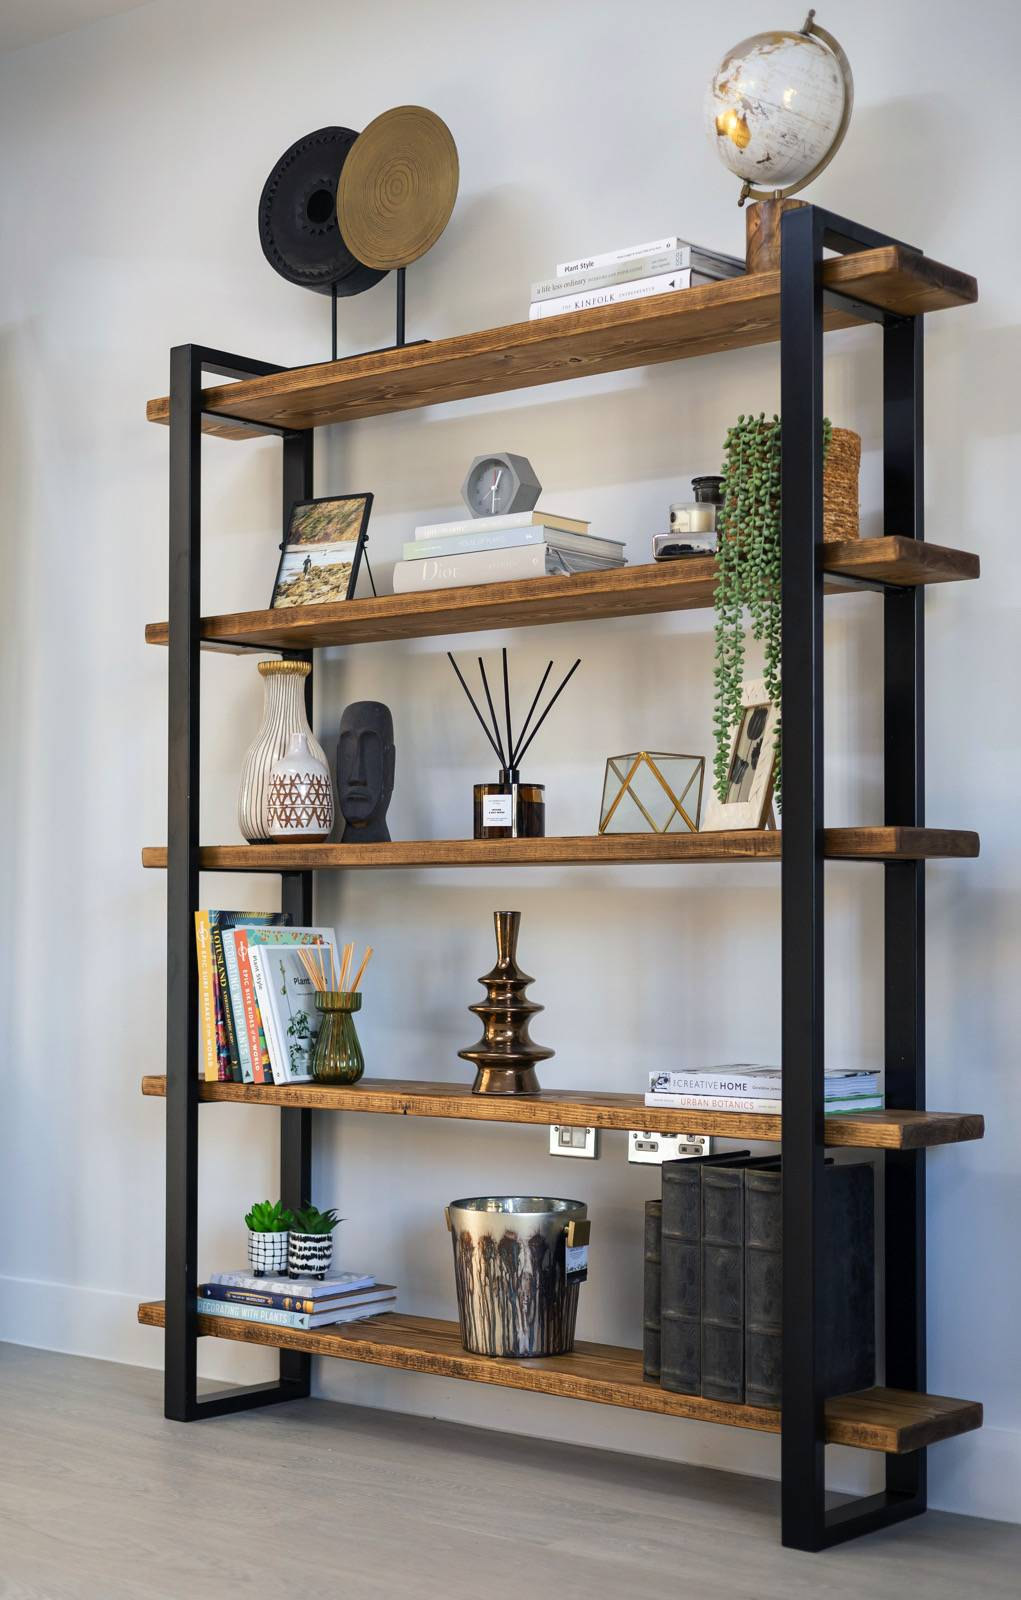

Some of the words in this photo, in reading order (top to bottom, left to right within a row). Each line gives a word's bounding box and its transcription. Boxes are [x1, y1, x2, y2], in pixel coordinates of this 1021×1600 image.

[564, 265, 579, 273] Plant
[580, 260, 595, 270] Style
[563, 278, 587, 288] ordinary
[574, 294, 615, 309] KINFOLK
[422, 560, 459, 582] Dior
[293, 977, 311, 985] Plant
[247, 1007, 255, 1028] RIDES
[252, 1043, 260, 1071] WORLD
[680, 1098, 708, 1107] URBAN
[712, 1099, 754, 1110] BOTANICS
